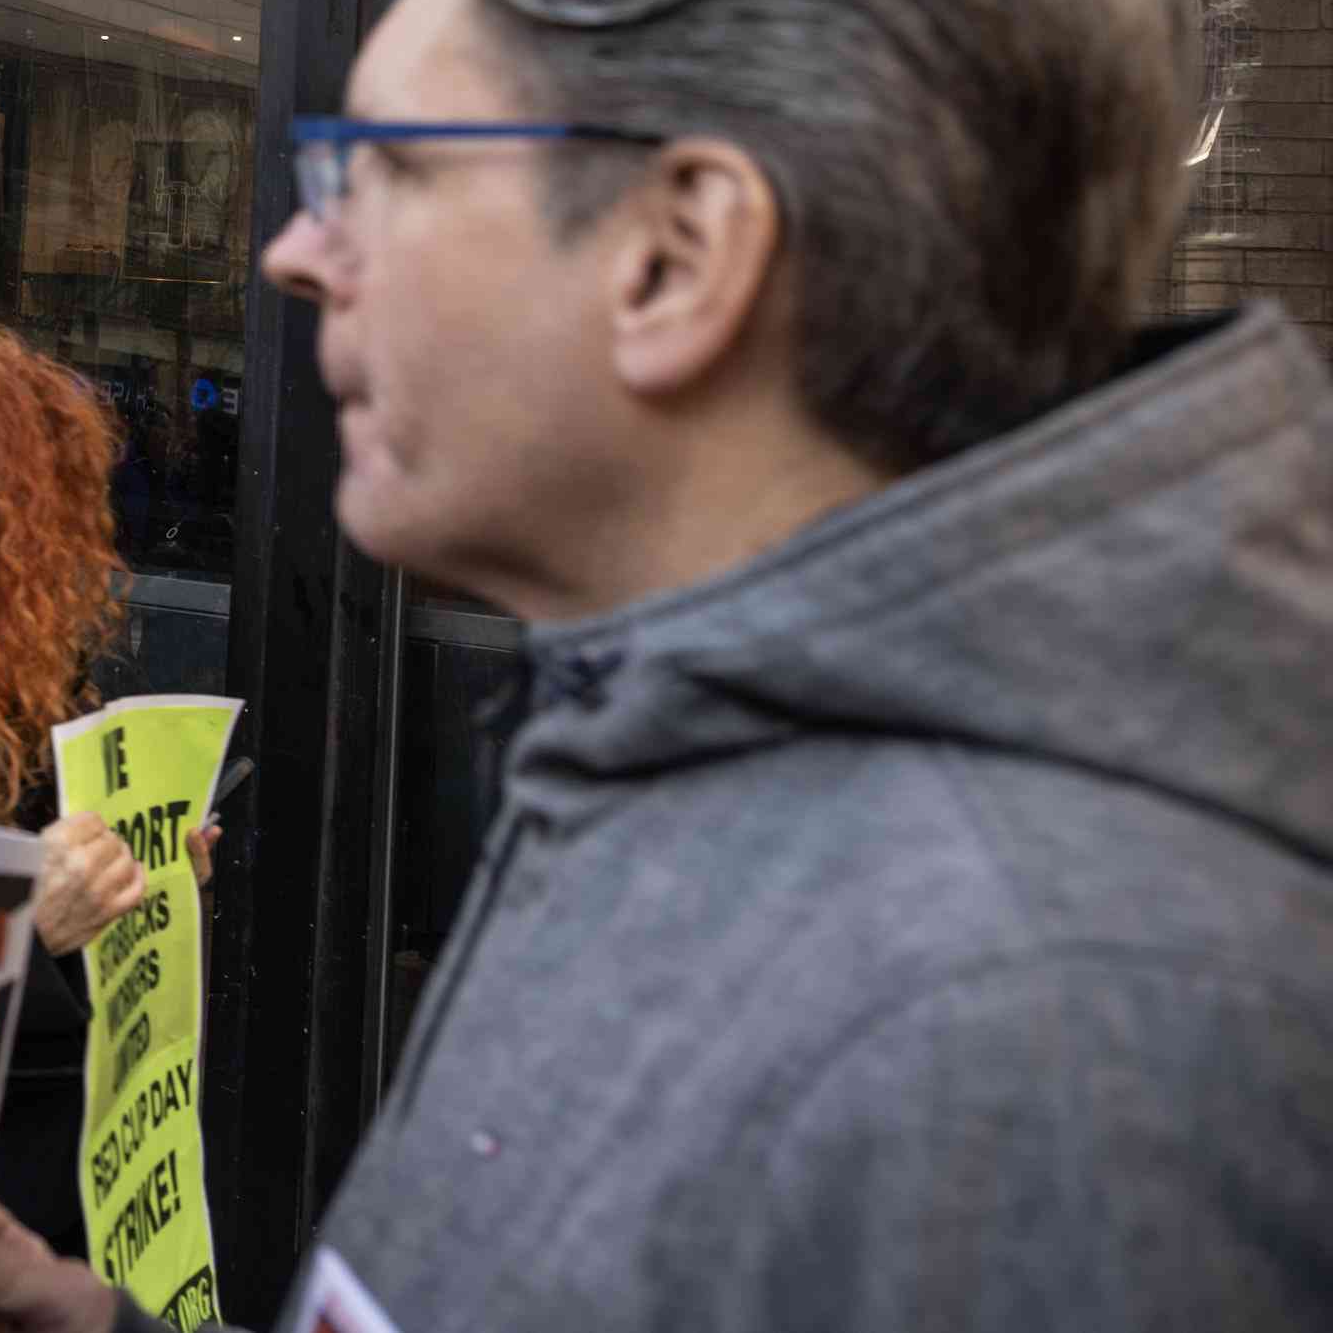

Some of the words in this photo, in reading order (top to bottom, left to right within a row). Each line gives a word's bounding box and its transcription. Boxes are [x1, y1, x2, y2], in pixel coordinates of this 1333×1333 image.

[92, 1130, 120, 1210] RED
[149, 1058, 193, 1129] DAY
[103, 1149, 182, 1291] STRIKE!
